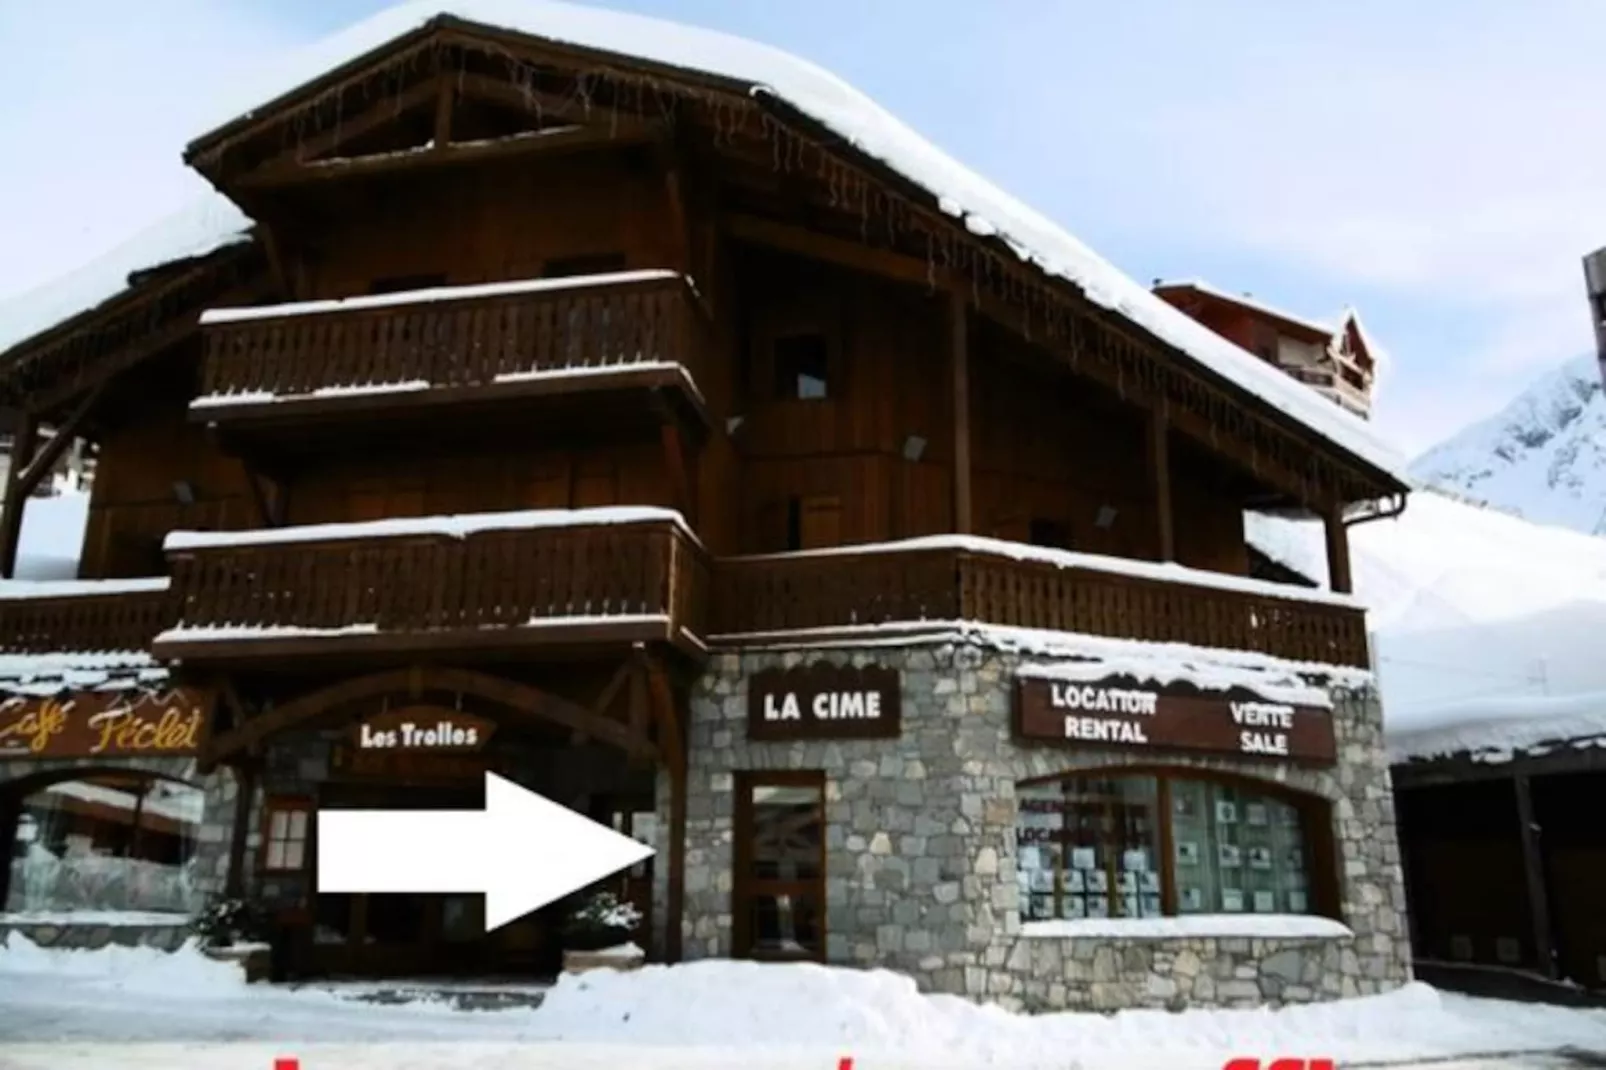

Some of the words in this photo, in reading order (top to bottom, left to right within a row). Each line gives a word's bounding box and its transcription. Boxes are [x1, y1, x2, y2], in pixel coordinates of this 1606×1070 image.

[764, 692, 801, 720] LA
[812, 690, 881, 719] CIME
[1052, 683, 1158, 715] LOCATION
[360, 722, 398, 748] Les
[400, 721, 477, 746] Trolles
[1064, 714, 1148, 743] RENTAL
[1240, 729, 1288, 756] SALE
